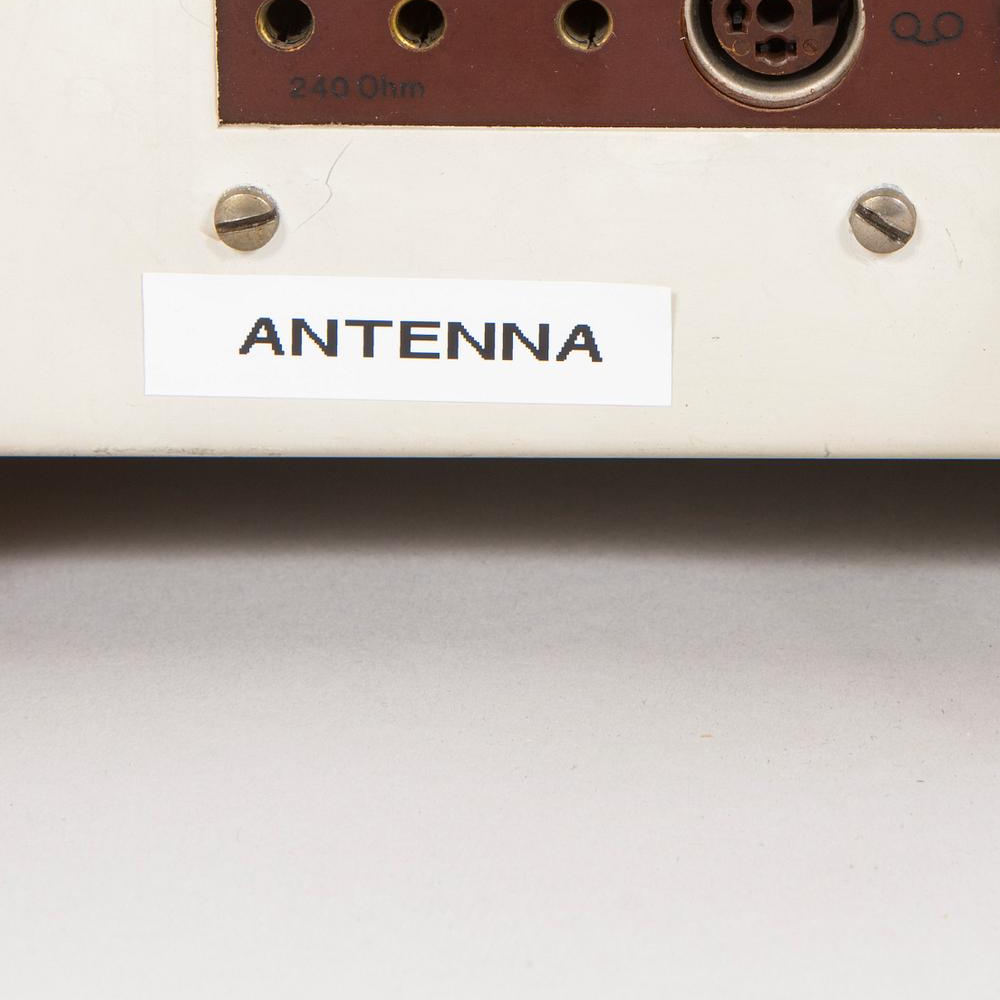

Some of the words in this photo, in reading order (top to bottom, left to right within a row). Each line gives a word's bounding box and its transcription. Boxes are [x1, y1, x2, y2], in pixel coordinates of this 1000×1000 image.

[289, 75, 349, 99] 240
[357, 72, 425, 99] Ohm
[239, 317, 603, 363] ANTENNA
